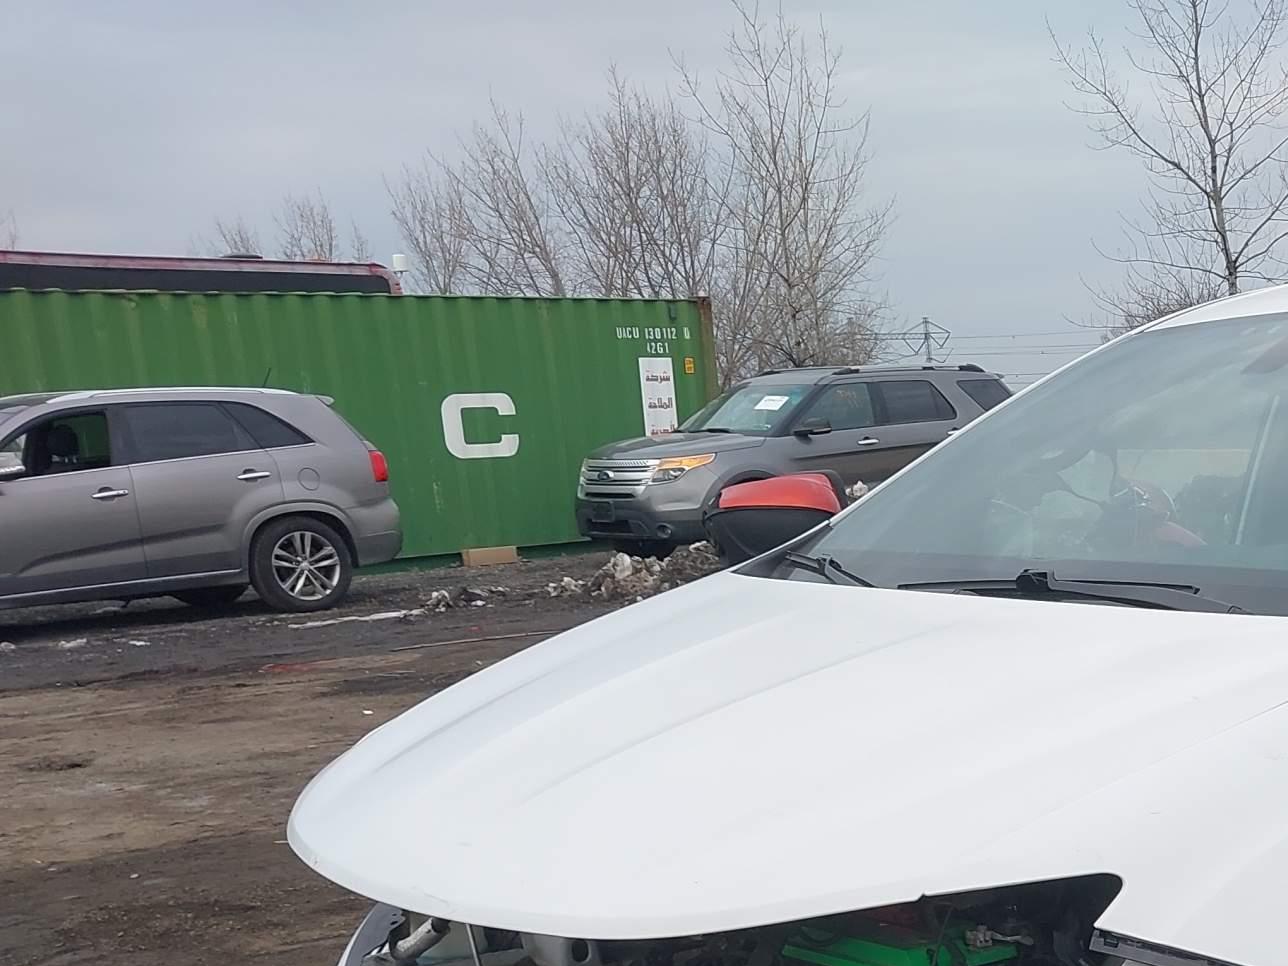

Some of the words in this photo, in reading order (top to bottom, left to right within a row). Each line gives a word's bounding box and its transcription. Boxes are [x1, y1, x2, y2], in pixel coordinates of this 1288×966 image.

[615, 326, 640, 339] UACU
[645, 327, 678, 340] 130112
[645, 370, 671, 384] شركة
[440, 392, 519, 459] C
